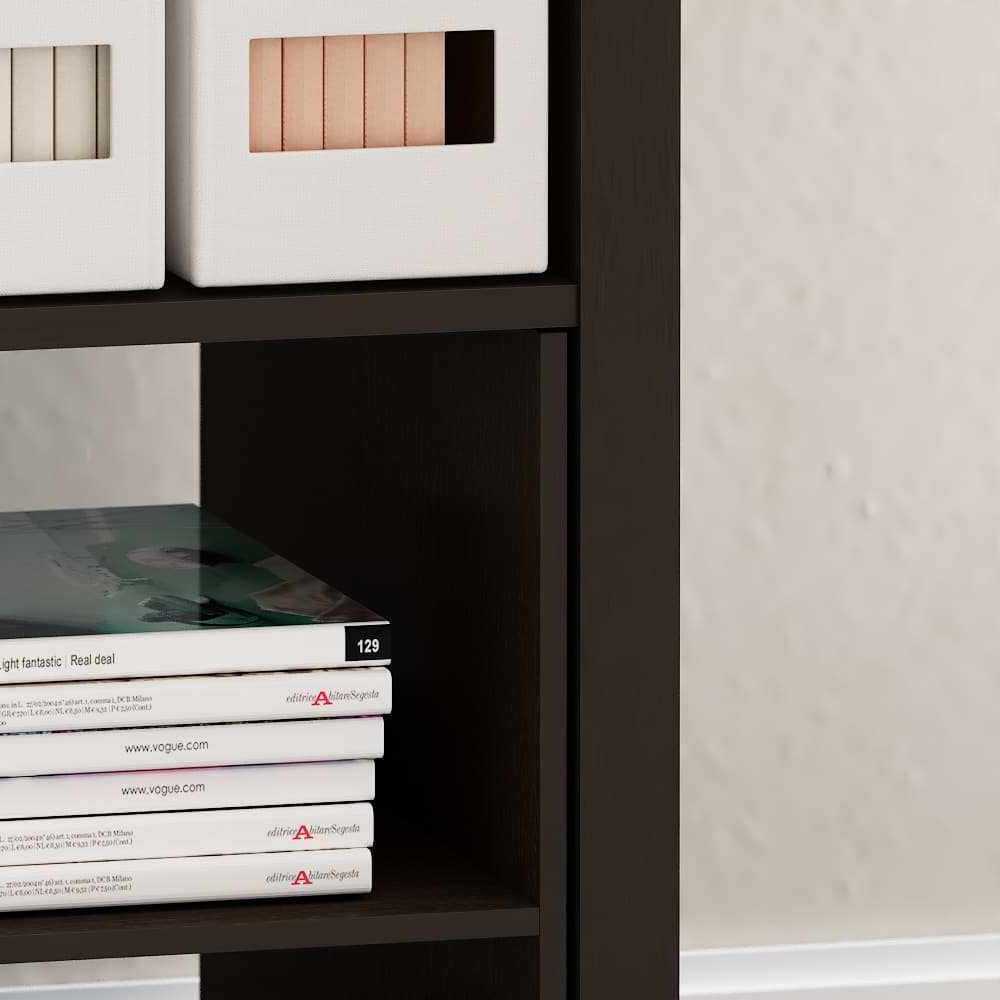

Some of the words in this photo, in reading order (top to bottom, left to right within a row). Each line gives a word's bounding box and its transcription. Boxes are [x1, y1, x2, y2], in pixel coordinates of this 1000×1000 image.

[21, 654, 62, 669] fantastic
[70, 653, 91, 666] Real
[95, 653, 115, 665] deal
[357, 638, 379, 654] 129
[124, 740, 209, 754] www.vogue.com
[121, 782, 205, 796] www.vogue.com
